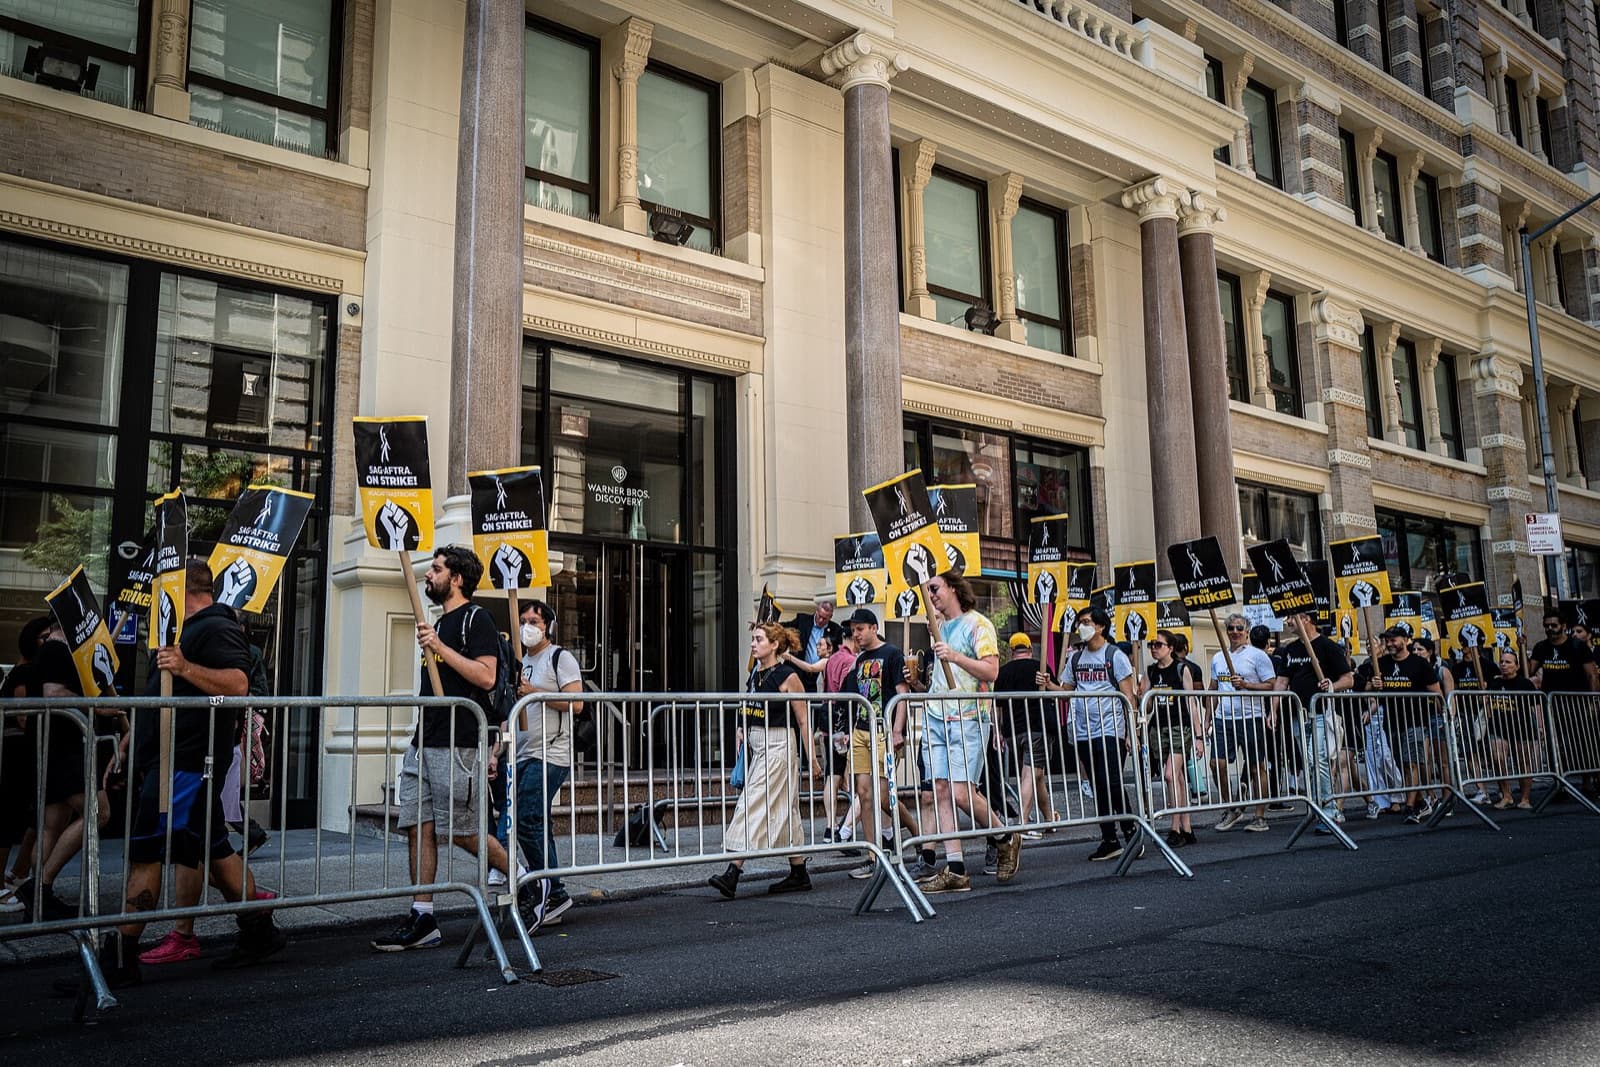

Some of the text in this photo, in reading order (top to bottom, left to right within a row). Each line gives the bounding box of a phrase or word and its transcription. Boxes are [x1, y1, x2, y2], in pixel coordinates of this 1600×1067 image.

[366, 475, 418, 486] ON STRIKE!
[587, 483, 650, 499] WARNER BROS.
[595, 493, 643, 506] DISCOVERY
[482, 519, 533, 532] ON STRIKE!
[888, 516, 927, 540] ON STRIKE!
[939, 524, 968, 532] TRIKE!
[230, 534, 281, 552] ON STRIKE!
[1184, 588, 1232, 606] STRIKE!
[1272, 593, 1314, 612] STRIKE!
